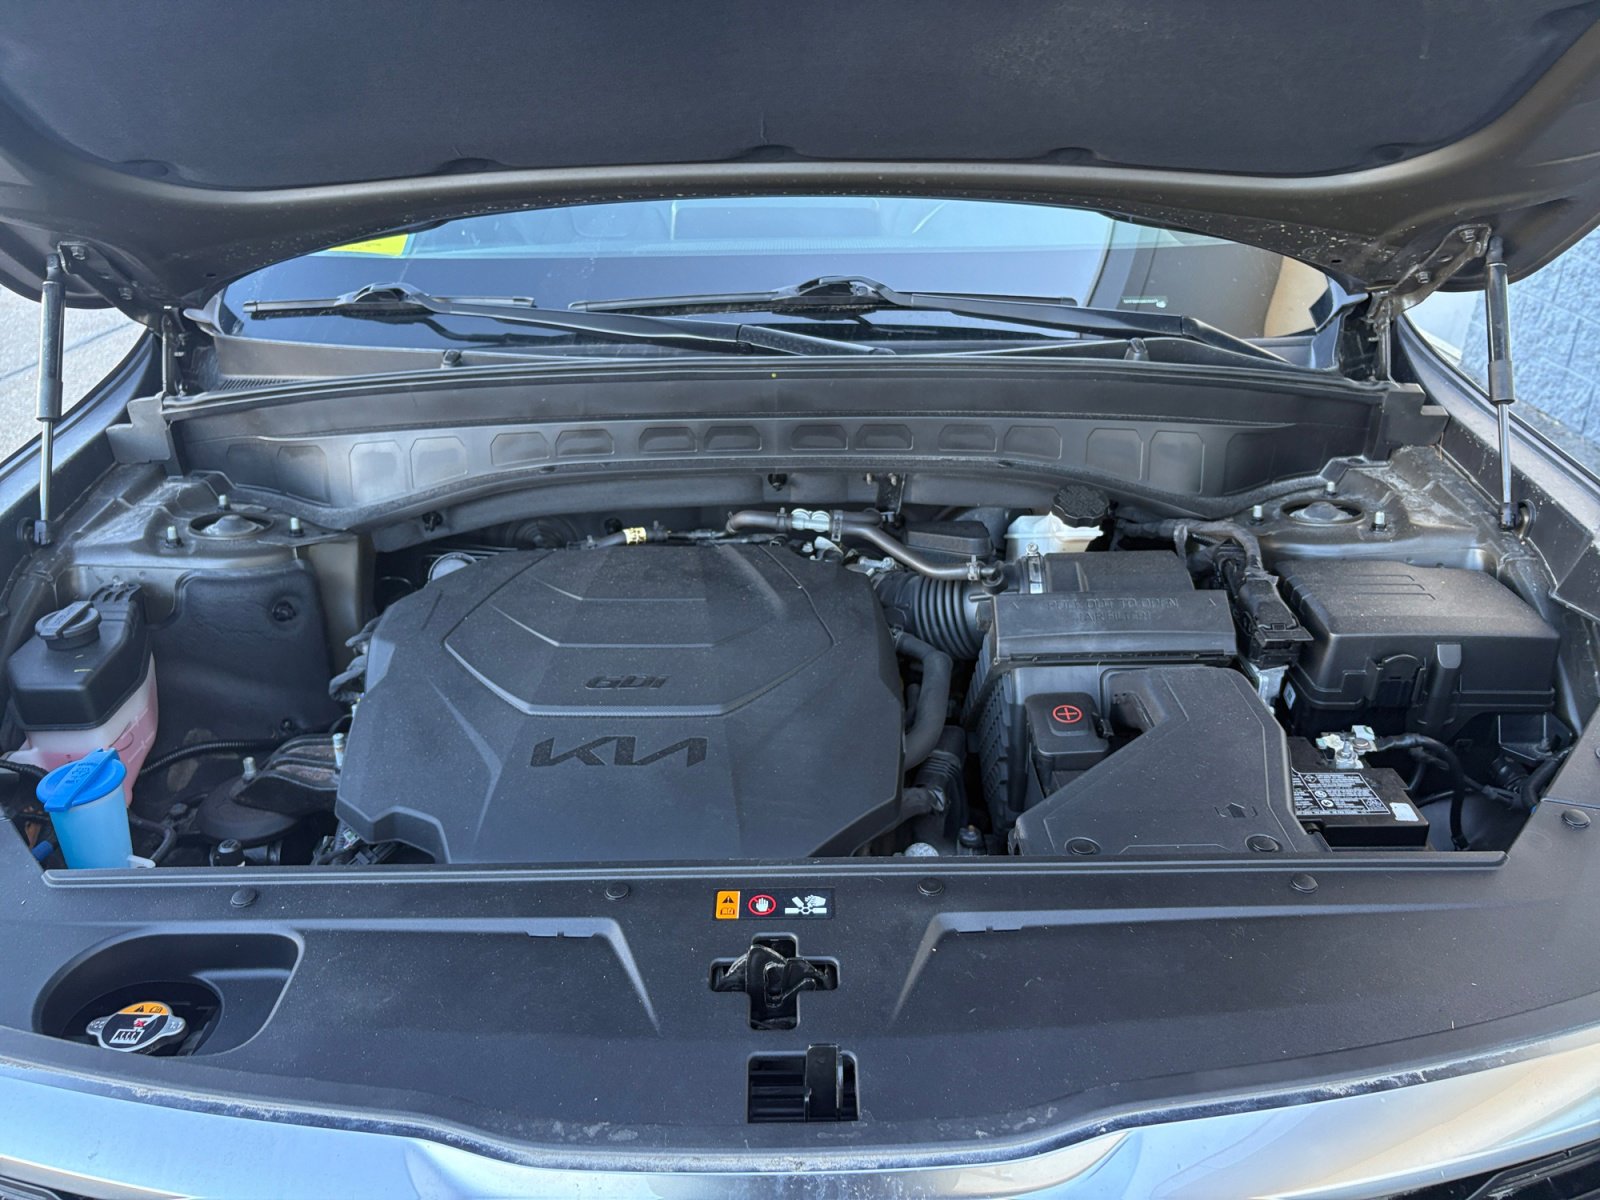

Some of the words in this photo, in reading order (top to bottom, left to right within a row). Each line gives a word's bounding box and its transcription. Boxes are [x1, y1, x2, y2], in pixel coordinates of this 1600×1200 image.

[1047, 599, 1082, 610] PULL
[1086, 598, 1114, 609] OUT
[1120, 598, 1138, 609] TO
[1141, 598, 1179, 609] OPEN
[530, 735, 708, 768] KIA
